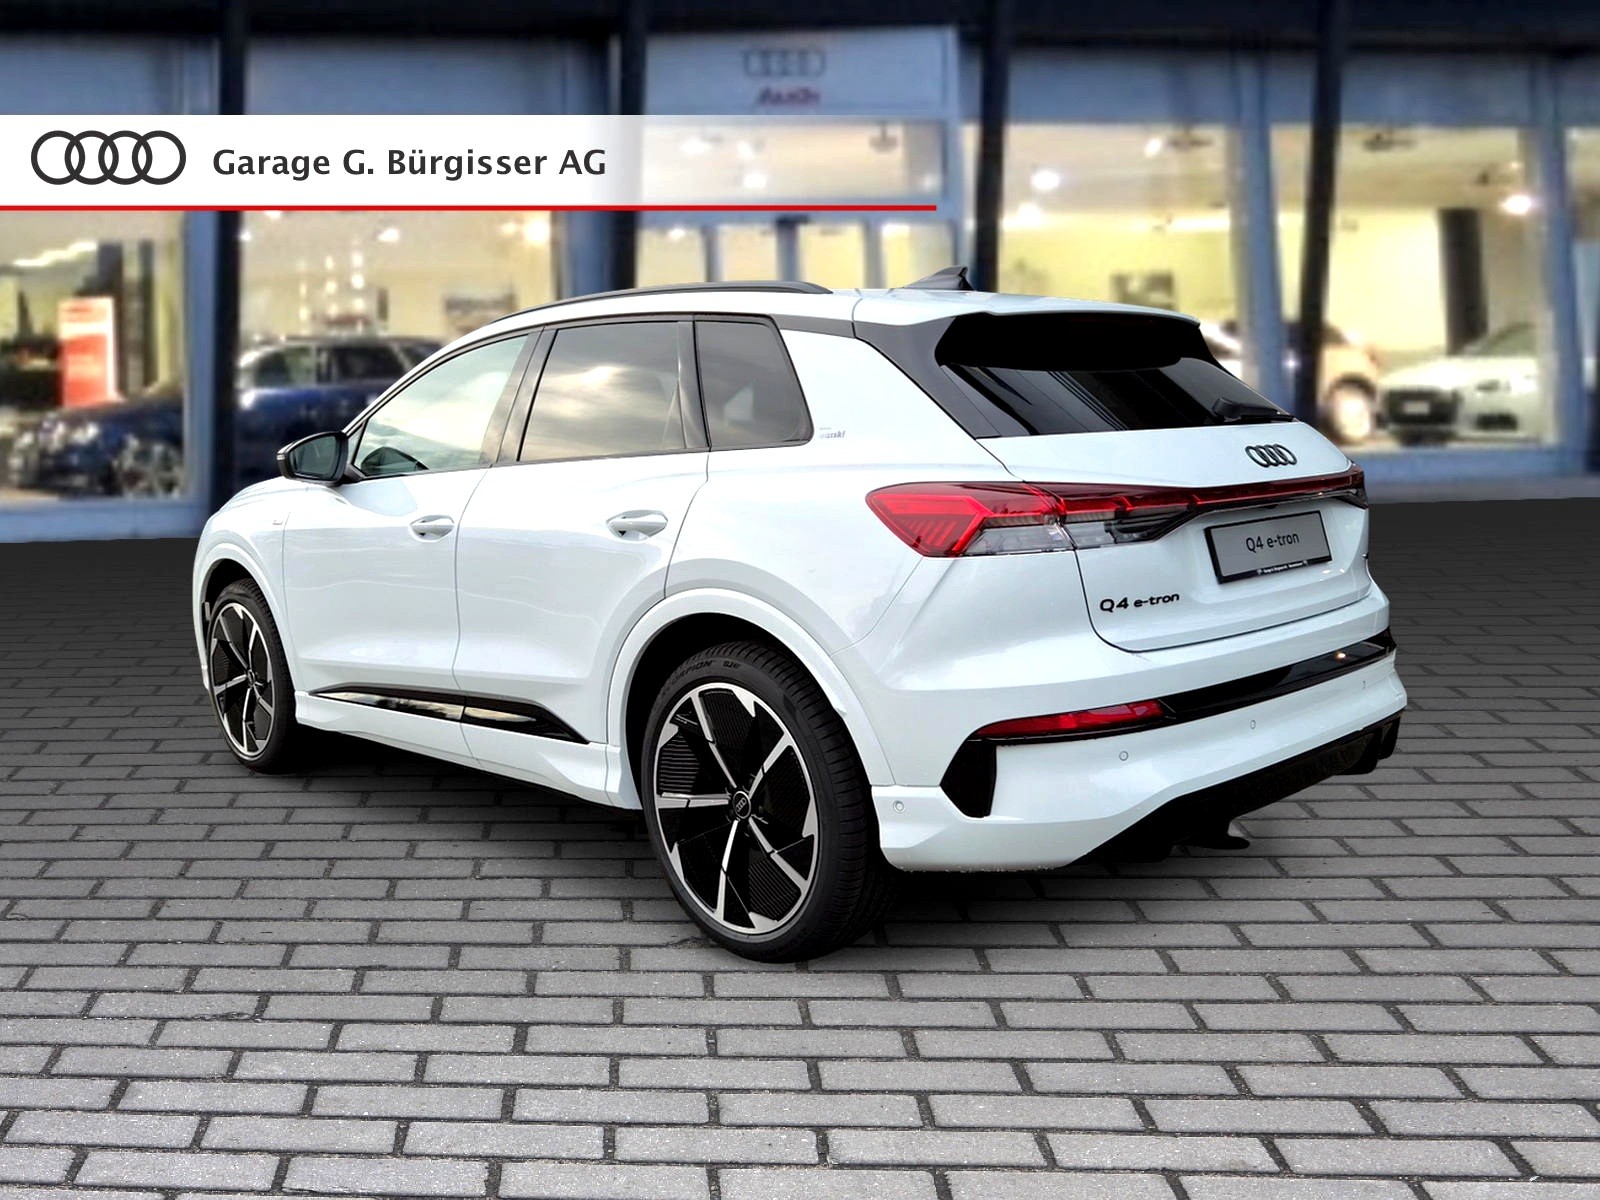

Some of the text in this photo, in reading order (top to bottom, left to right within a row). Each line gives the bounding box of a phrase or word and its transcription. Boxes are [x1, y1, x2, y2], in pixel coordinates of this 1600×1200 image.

[1246, 536, 1264, 553] Q4
[1099, 593, 1180, 613] Q4 e-tron
